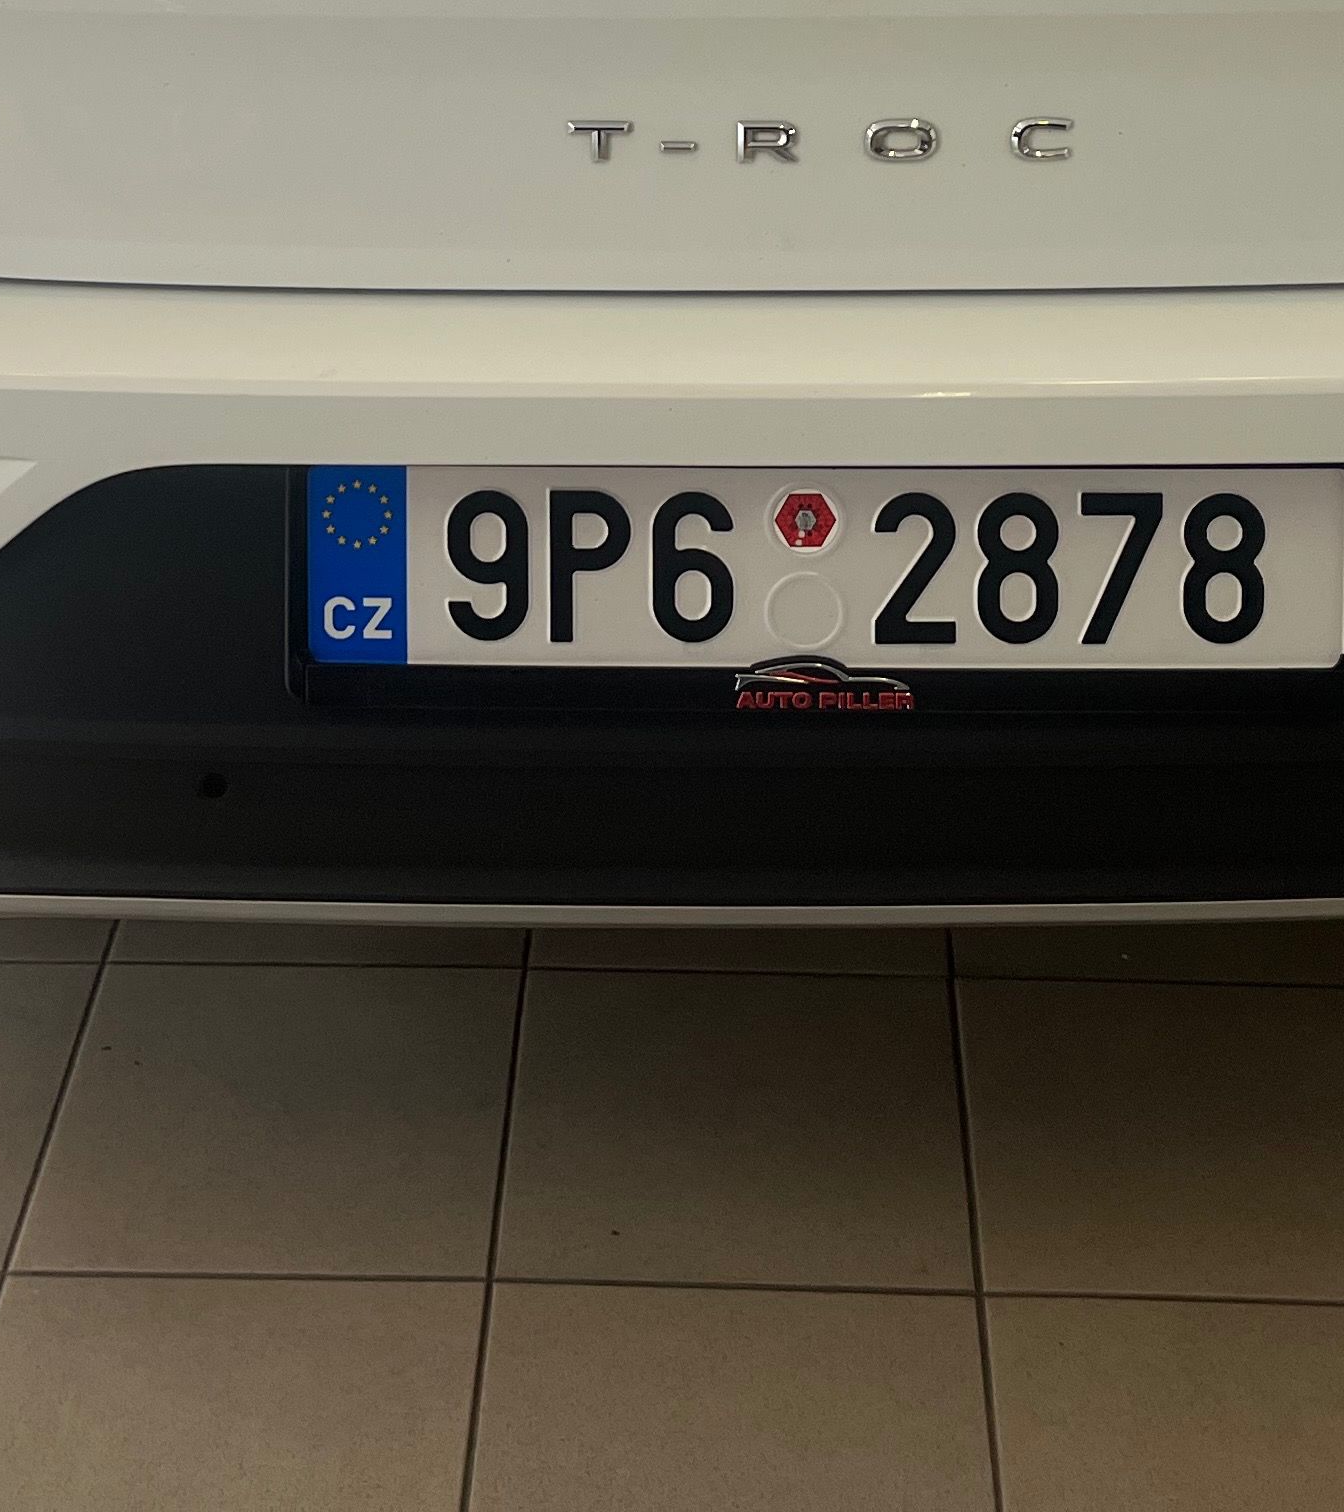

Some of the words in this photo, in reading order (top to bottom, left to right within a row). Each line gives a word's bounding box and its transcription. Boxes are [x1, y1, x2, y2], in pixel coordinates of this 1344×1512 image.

[446, 489, 735, 643] 9P6
[873, 491, 1267, 645] 2878
[323, 595, 393, 640] CZ
[736, 691, 813, 710] AUTO
[818, 691, 915, 710] PILLER
